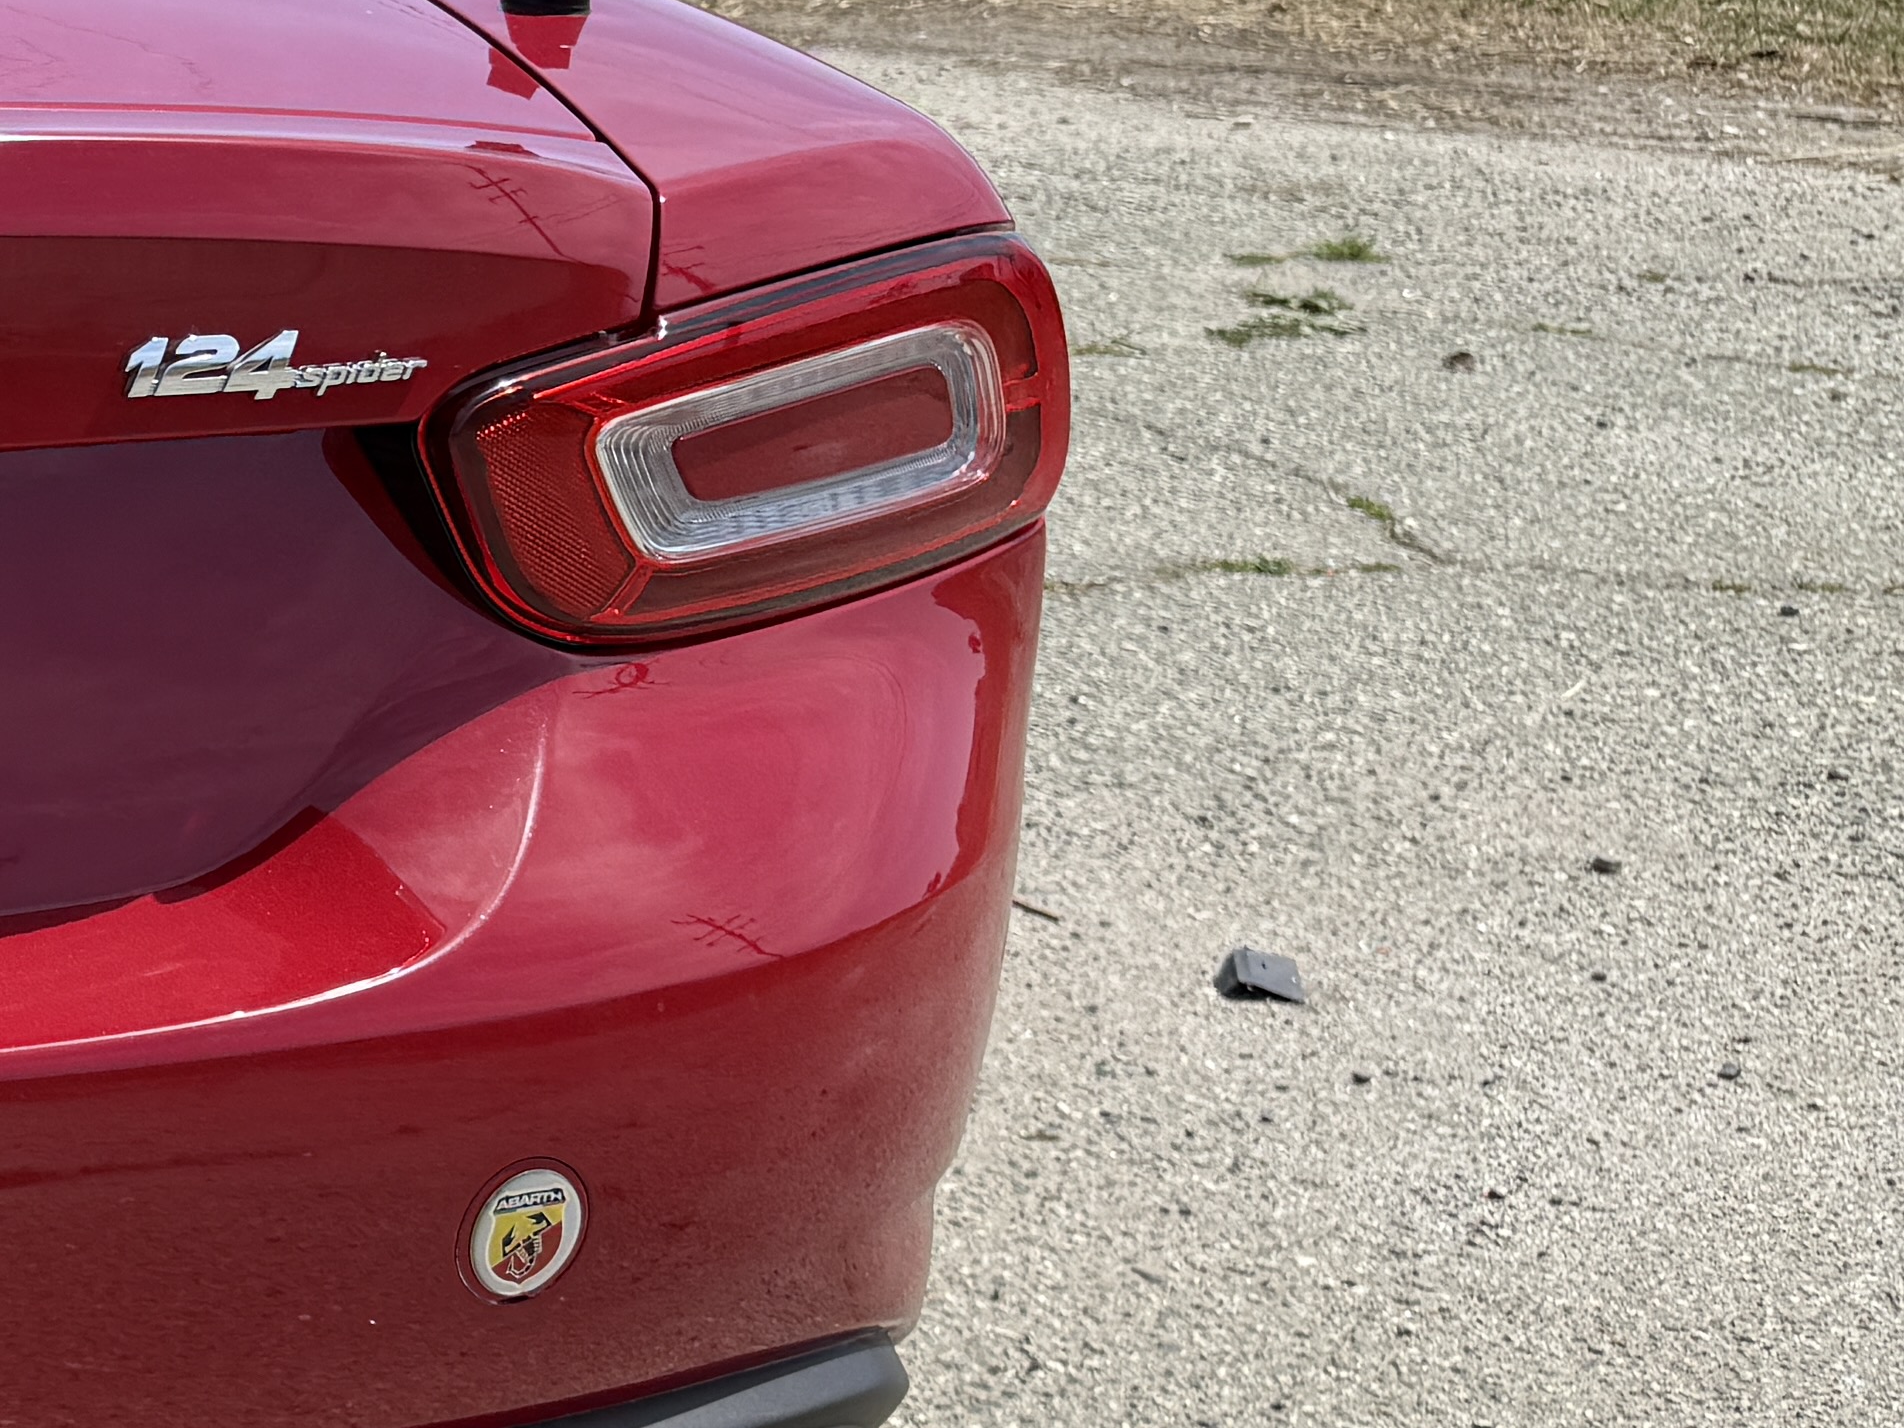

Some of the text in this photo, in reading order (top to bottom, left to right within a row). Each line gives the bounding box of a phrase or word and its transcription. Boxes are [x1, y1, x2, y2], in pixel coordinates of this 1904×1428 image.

[125, 329, 427, 401] 124 spider
[496, 1191, 563, 1210] ABARTH
